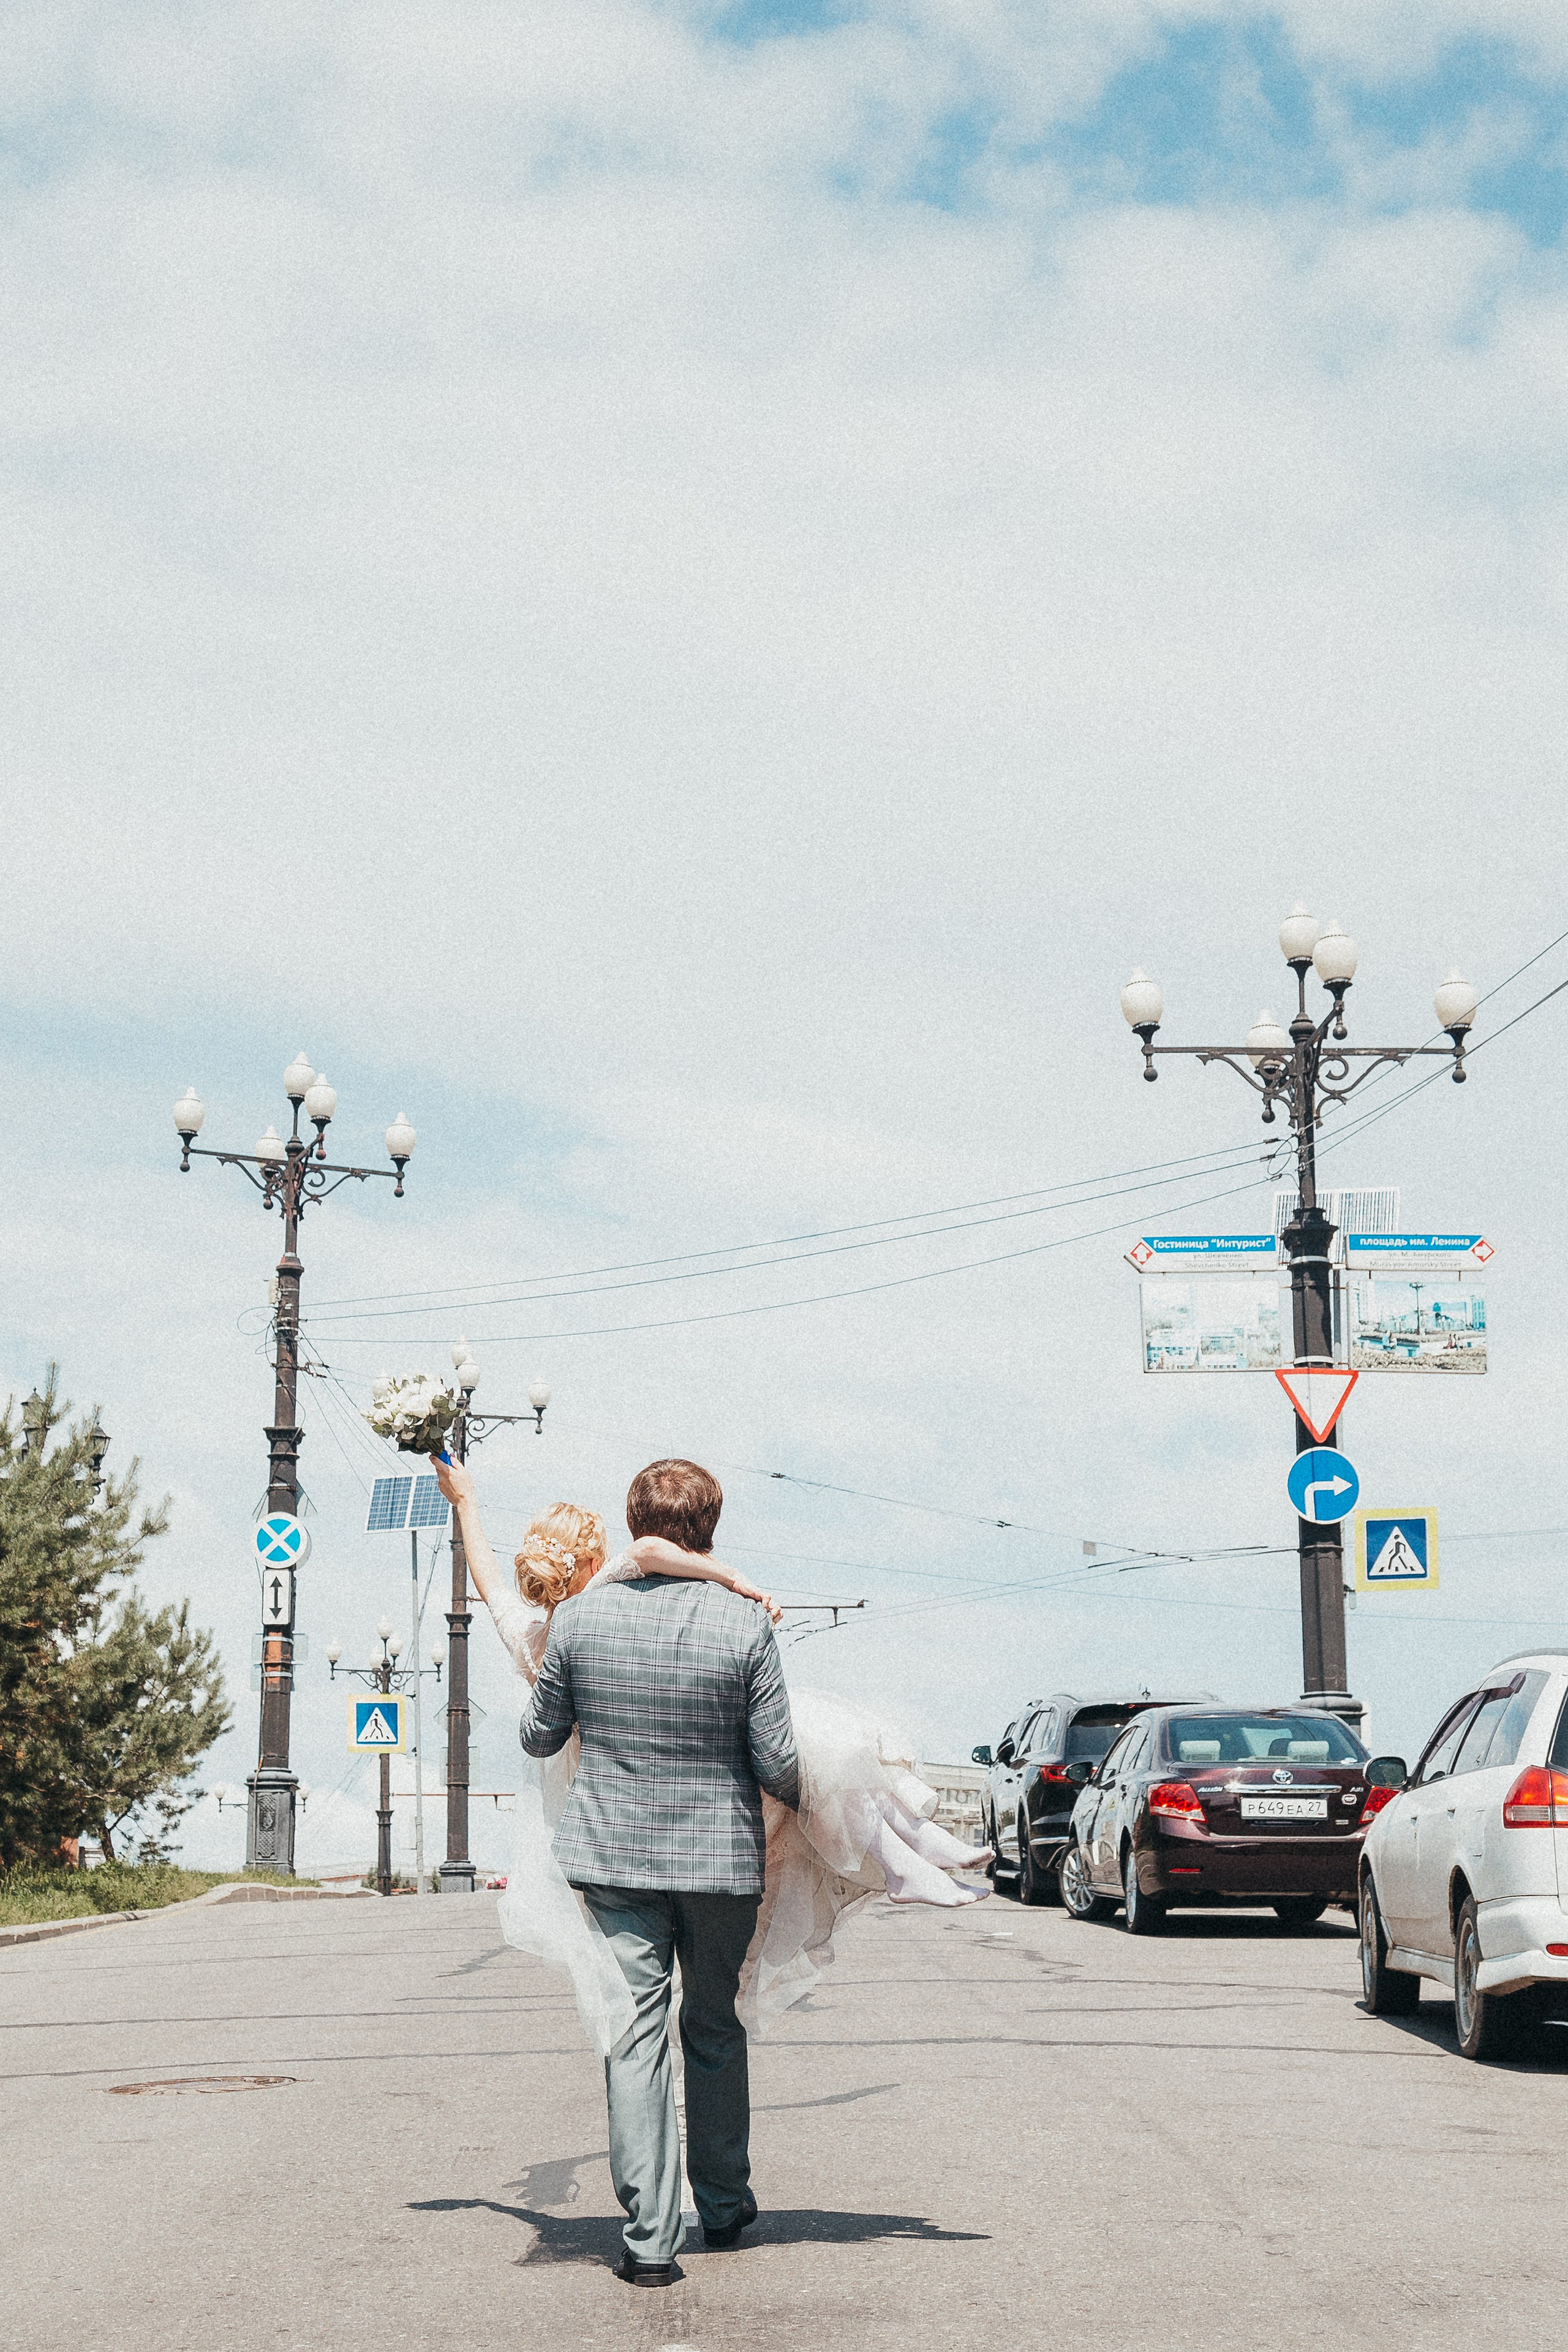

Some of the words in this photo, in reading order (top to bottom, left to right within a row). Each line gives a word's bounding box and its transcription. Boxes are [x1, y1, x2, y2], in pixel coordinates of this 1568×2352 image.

[1153, 1240, 1209, 1250] Гостиница
[1360, 1238, 1408, 1247] площадь
[1431, 1237, 1470, 1246] Ленина
